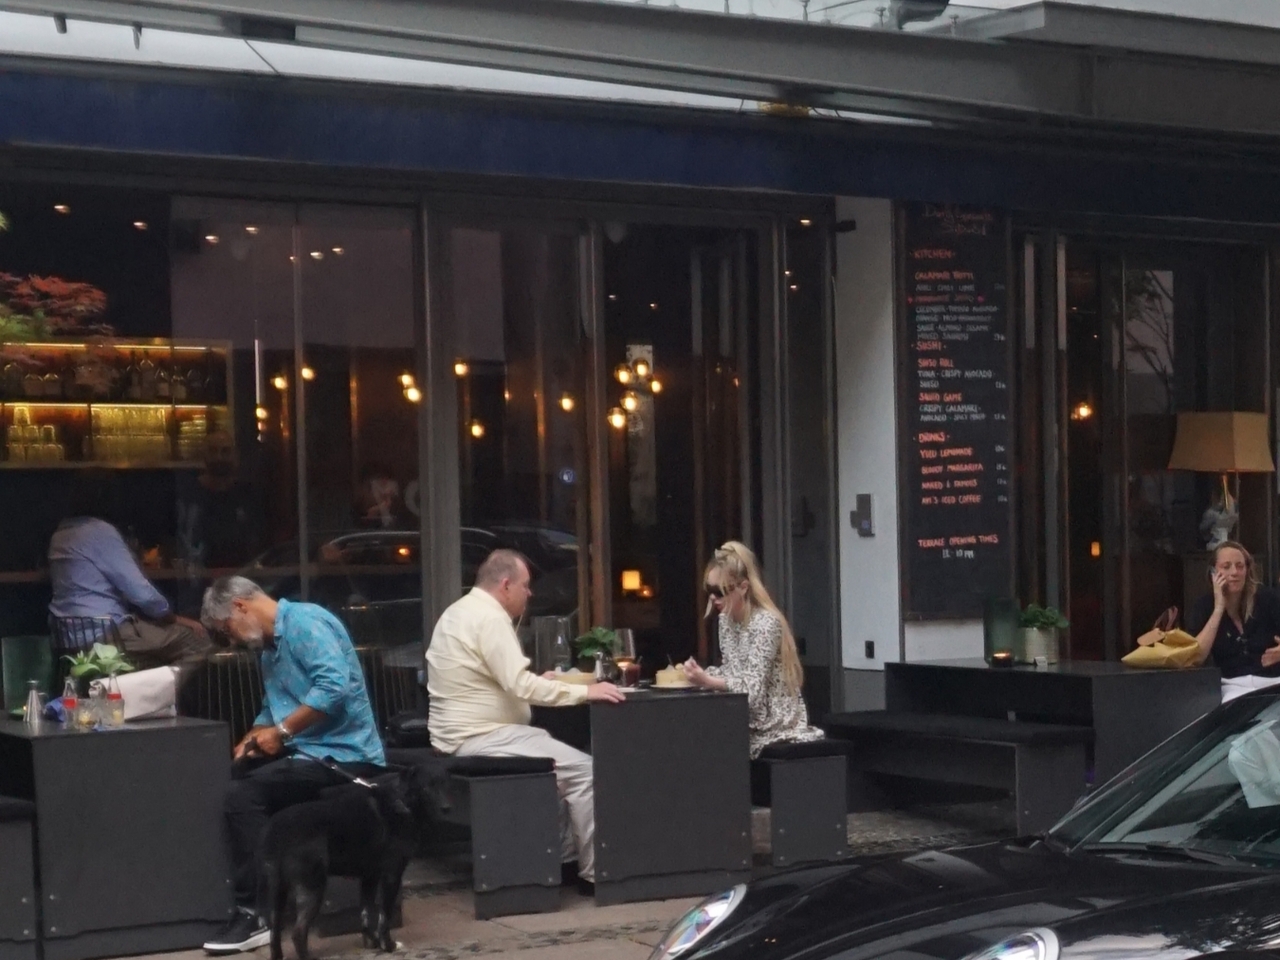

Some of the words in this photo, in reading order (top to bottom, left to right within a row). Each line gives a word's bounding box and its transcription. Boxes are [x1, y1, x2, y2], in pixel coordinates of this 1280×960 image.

[917, 340, 943, 351] SUSHI
[917, 370, 936, 379] TUNA
[943, 392, 962, 402] GAME
[918, 432, 946, 443] DRINKS
[940, 447, 974, 458] LEMONADE
[959, 494, 982, 504] COFFEE
[918, 538, 947, 548] TERRACE
[949, 535, 977, 546] OPENING
[979, 533, 1000, 544] TIMES
